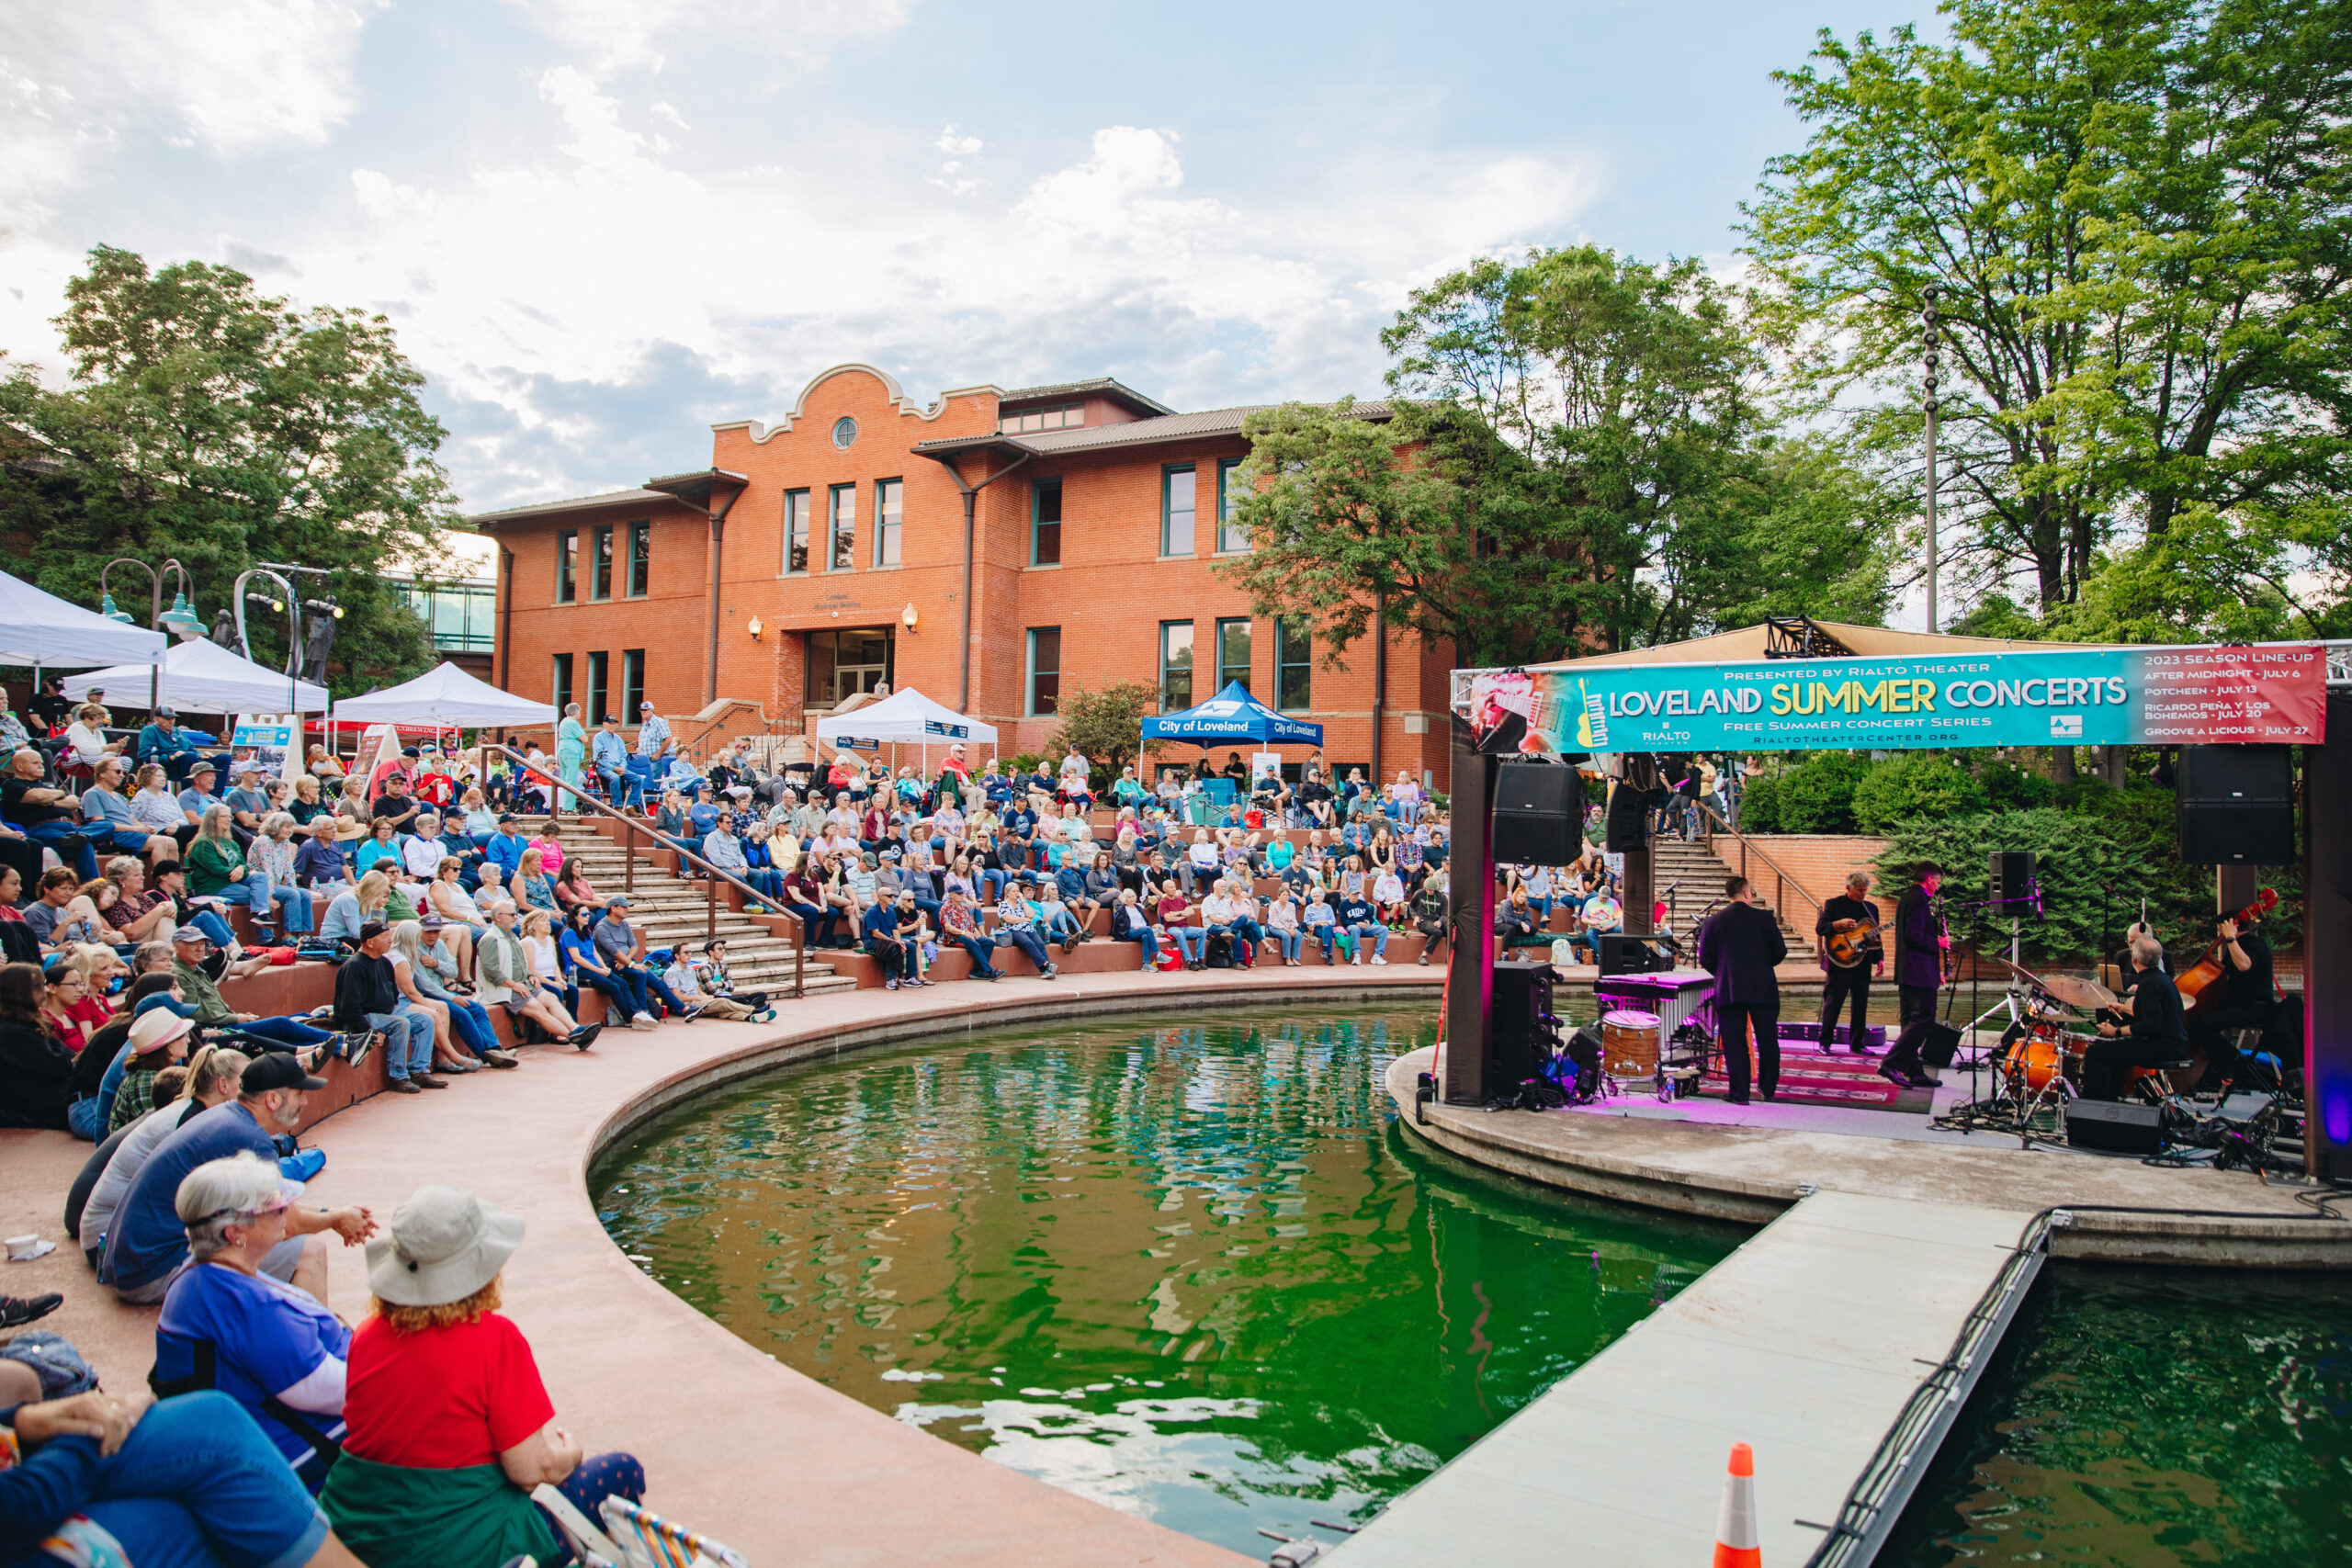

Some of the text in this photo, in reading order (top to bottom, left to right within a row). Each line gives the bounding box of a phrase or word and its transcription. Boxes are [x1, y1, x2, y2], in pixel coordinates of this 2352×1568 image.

[2144, 653, 2314, 666] 2023 SEASON LINE-UP
[1724, 663, 1991, 681] PRESENTED BY RIALTO THEATER
[2144, 671, 2184, 681] AFTER
[2187, 669, 2253, 680] MIDNIGHT
[2262, 670, 2289, 680] JULY
[2291, 669, 2301, 679] 6
[1609, 676, 2128, 716] LOVELAND SUMMER CONCERTS
[2144, 687, 2208, 696] POTCHEEN
[2216, 685, 2244, 696] JULY
[2245, 684, 2257, 694] 13
[2144, 700, 2271, 712] RICARDO PEÑA Y LOS
[2144, 711, 2208, 720] BOHEMIOS
[2217, 710, 2244, 721] JULY
[2245, 709, 2262, 718] 20
[1159, 720, 1249, 733] City of Loveland
[1274, 722, 1317, 738] City of Loveland
[1724, 716, 1993, 732] FREE SUMMER CONCERT SERIES
[1642, 731, 1690, 740] RIALTO
[2144, 728, 2195, 736] GROOVE
[2197, 728, 2206, 736] A
[2208, 726, 2256, 736] LICIOUS
[2265, 726, 2291, 736] JULY
[2293, 726, 2309, 735] 27
[1753, 733, 1960, 745] RIALTOTHEATERCENTER.ORG
